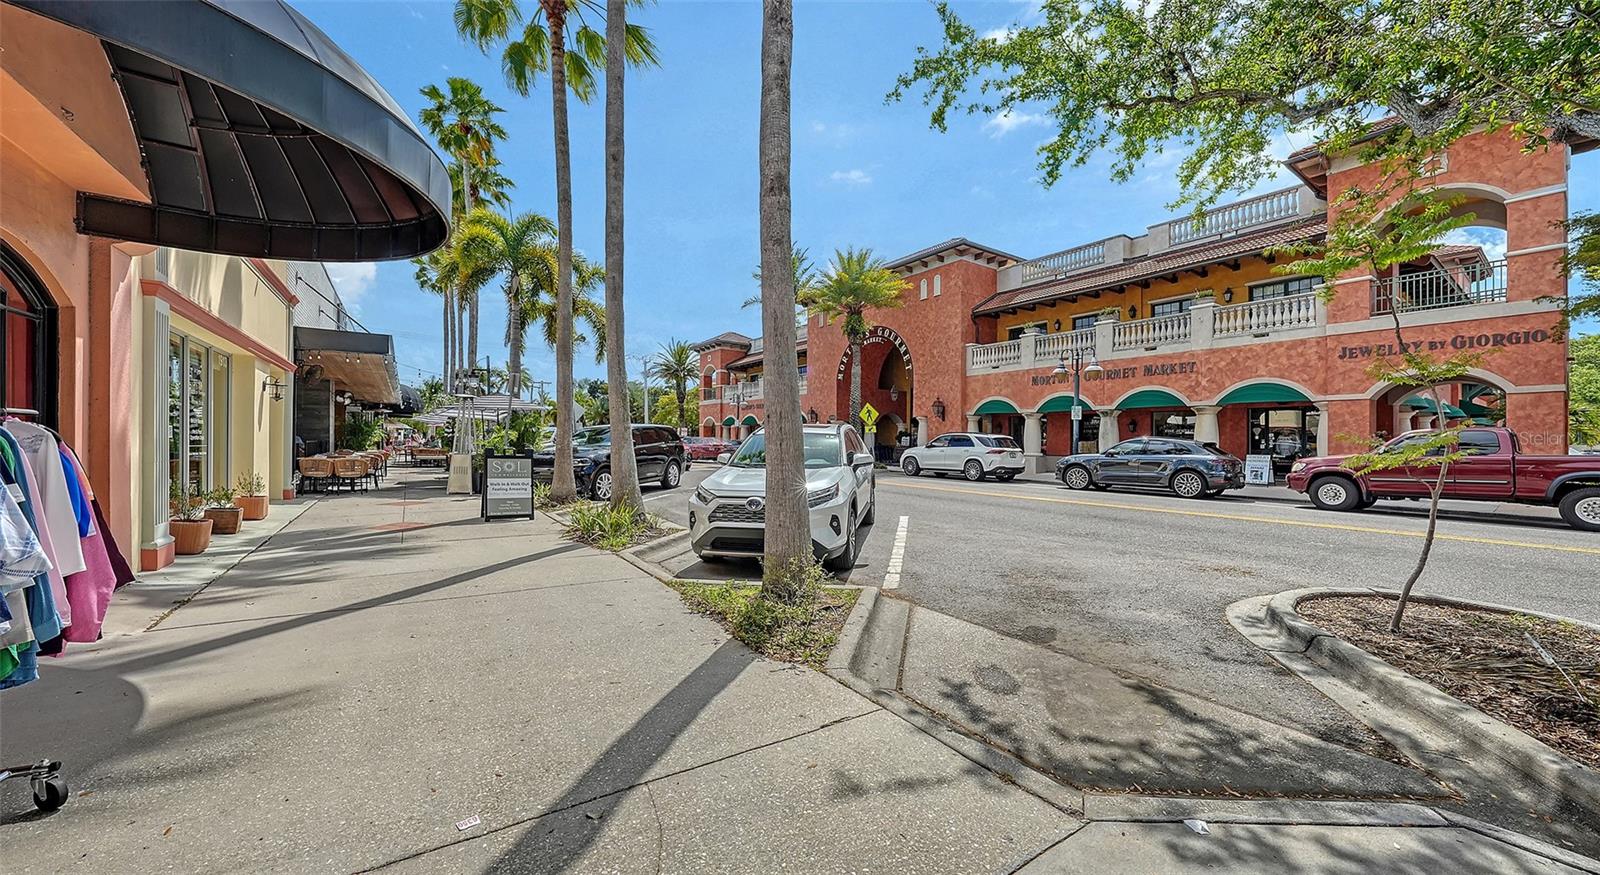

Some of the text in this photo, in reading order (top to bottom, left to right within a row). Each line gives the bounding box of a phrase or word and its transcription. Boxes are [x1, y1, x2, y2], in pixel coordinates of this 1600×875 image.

[877, 327, 913, 371] GOURMET
[1338, 329, 1548, 360] JEWELRY BY GIORGIO
[1143, 361, 1196, 376] MARKET
[492, 461, 527, 473] SOL
